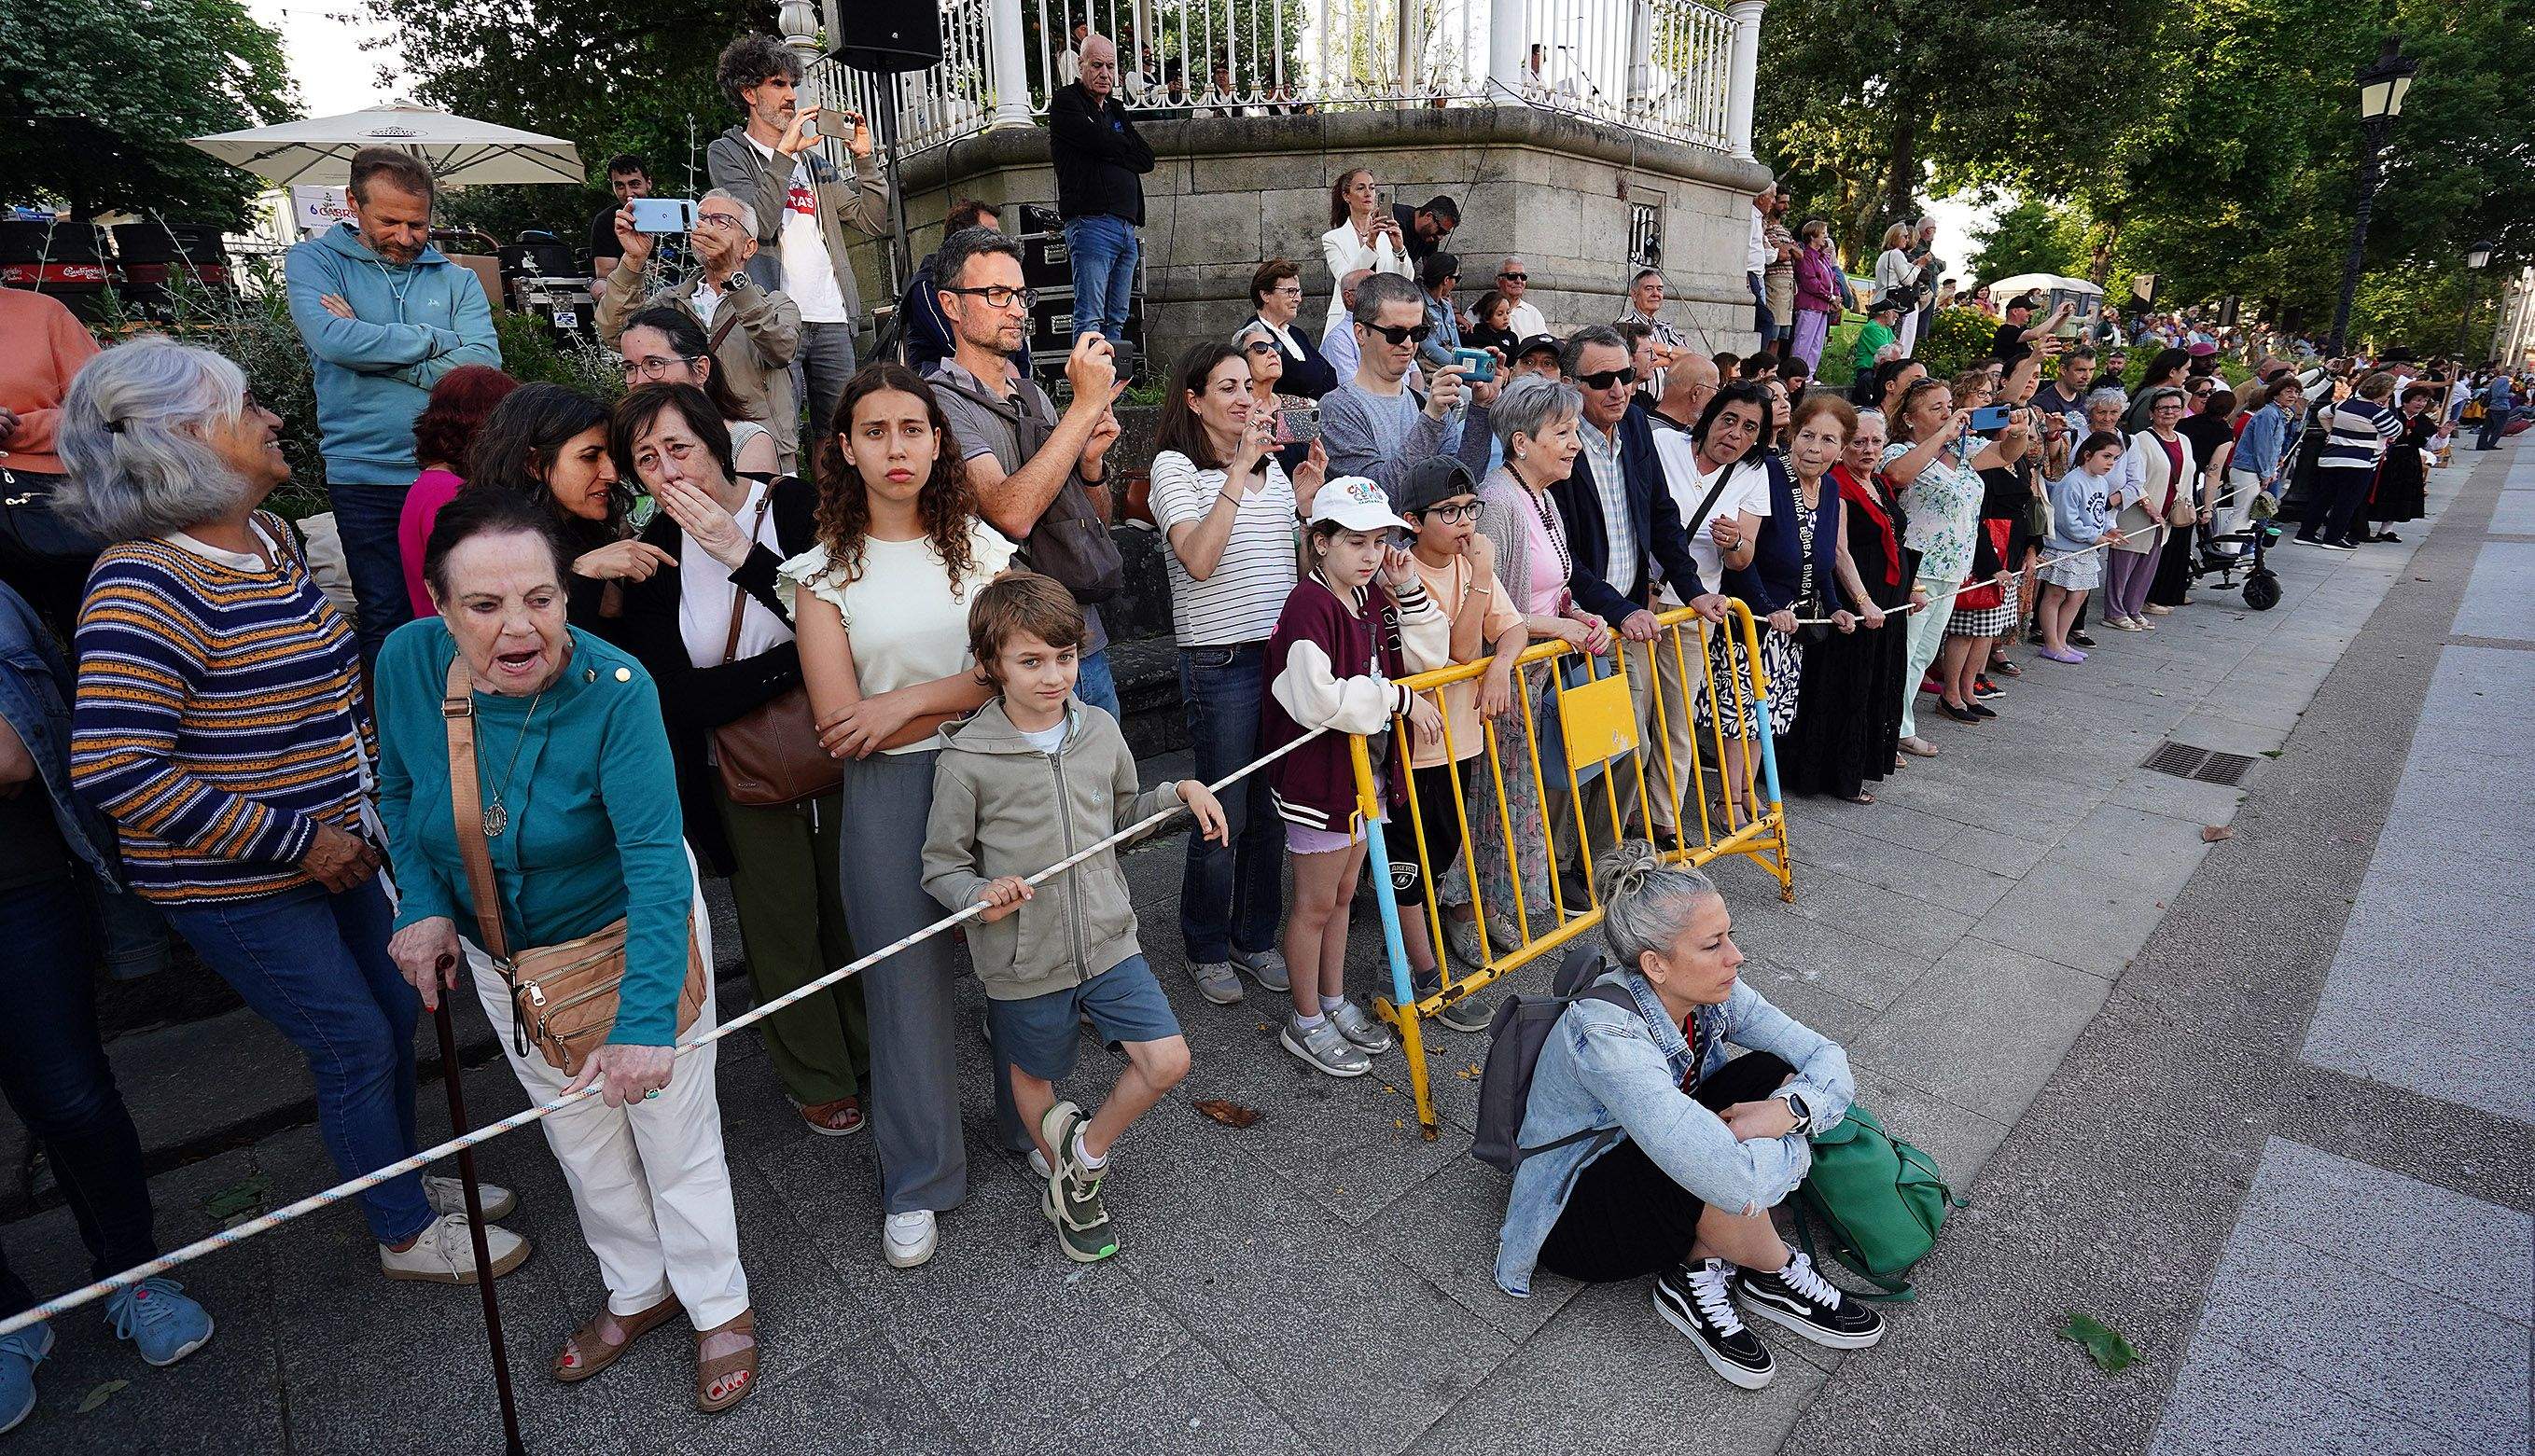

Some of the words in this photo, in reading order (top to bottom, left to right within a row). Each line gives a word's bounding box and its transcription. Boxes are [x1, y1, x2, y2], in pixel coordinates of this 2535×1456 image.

[1778, 455, 1798, 483] BIMBA
[1791, 488, 1805, 521] BIMBA
[1801, 563, 1813, 596] BIMBA
[1391, 865, 1415, 873] AKERS
